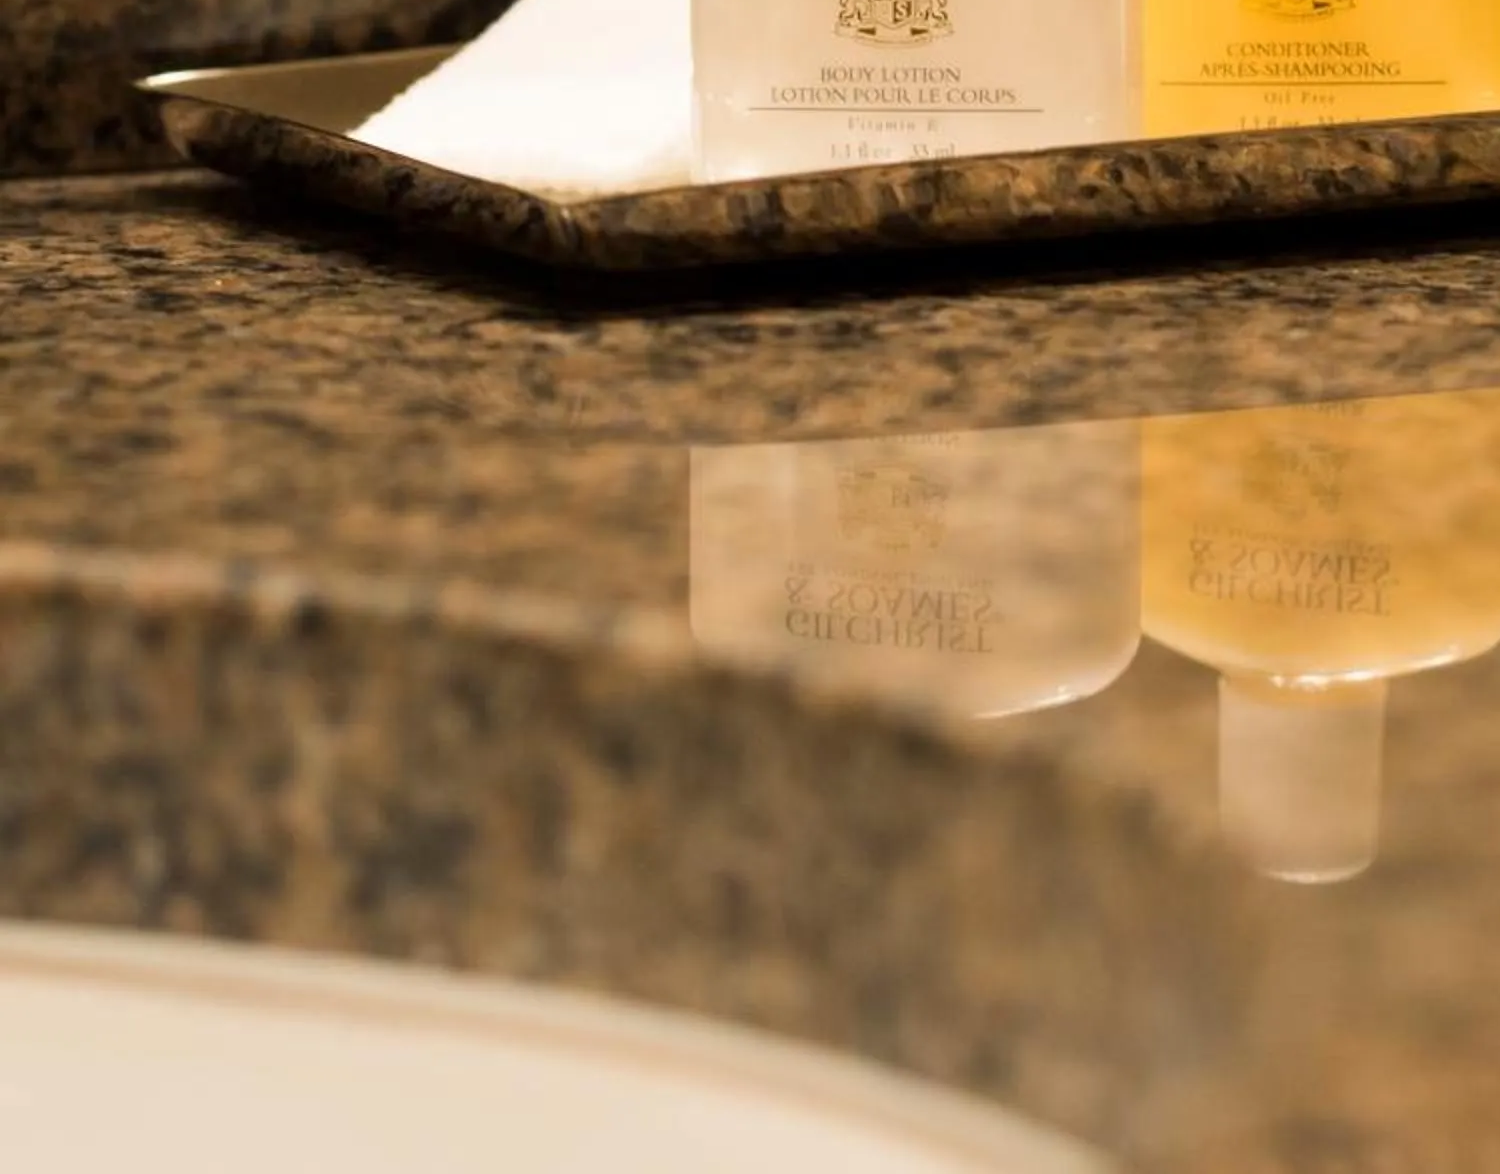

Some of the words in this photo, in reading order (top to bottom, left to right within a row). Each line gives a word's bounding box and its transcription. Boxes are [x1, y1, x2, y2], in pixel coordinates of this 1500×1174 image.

[1226, 42, 1370, 57] CONDITIONER
[820, 67, 875, 83] BODY
[882, 67, 961, 83] LOTION
[771, 87, 848, 103] LOTION
[853, 87, 911, 103] POUR
[918, 87, 941, 103] LE
[946, 87, 1017, 104] CORPS
